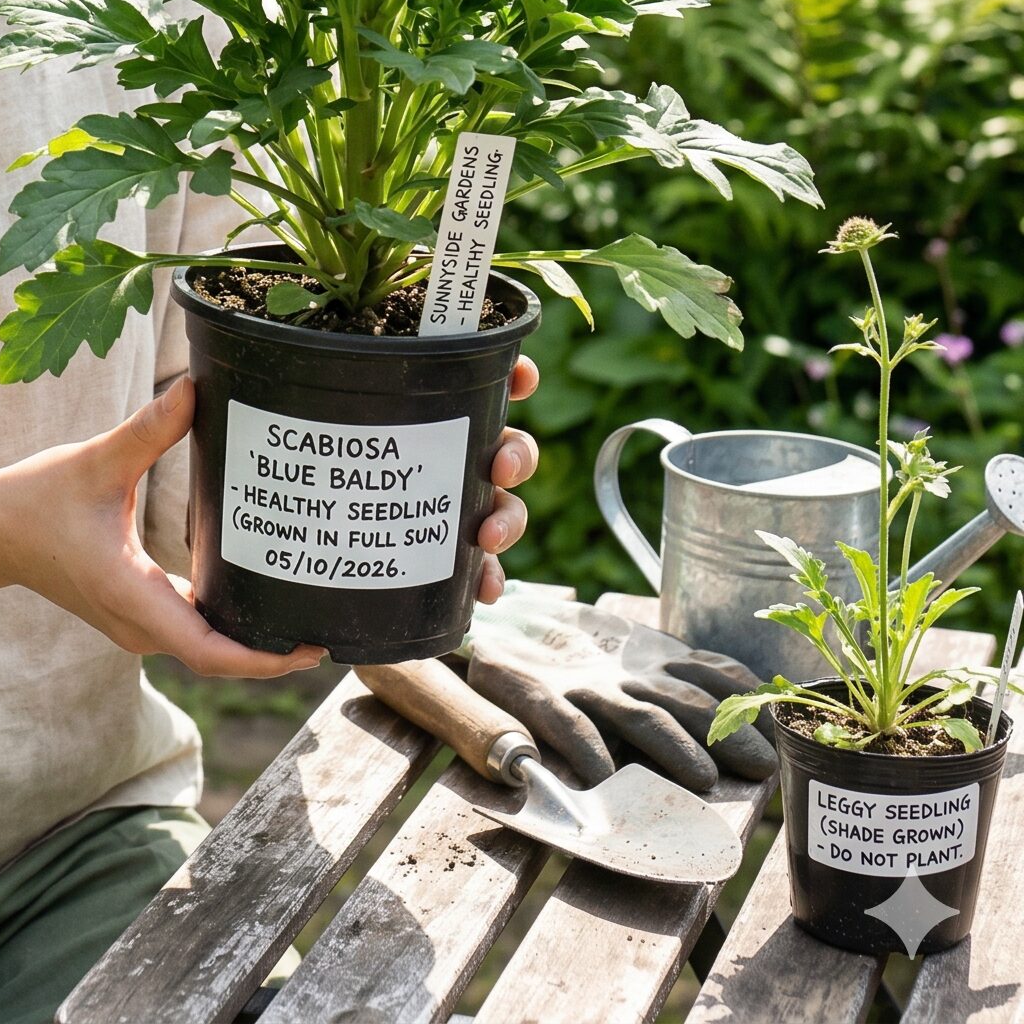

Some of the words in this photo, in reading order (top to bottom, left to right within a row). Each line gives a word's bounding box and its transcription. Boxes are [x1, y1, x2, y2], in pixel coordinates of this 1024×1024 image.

[430, 231, 463, 324] SUNNYSIDE
[452, 146, 479, 222] GARDENS
[457, 239, 486, 311] HEALTHY
[267, 424, 400, 460] SCABIOSA
[347, 494, 451, 521] SEEDLING
[232, 506, 307, 542] (GROWN
[316, 529, 339, 547] IN
[348, 531, 397, 548] FULL
[403, 519, 449, 546] SUN)
[265, 549, 406, 580] 05/10/2026.
[817, 790, 877, 819] LEGGY
[885, 793, 971, 820] SEEDLING
[820, 815, 884, 844] (SHADE
[892, 818, 964, 845] GROWN)
[830, 843, 852, 862] DO
[860, 852, 898, 868] NOT
[906, 844, 963, 869] PLANT.
